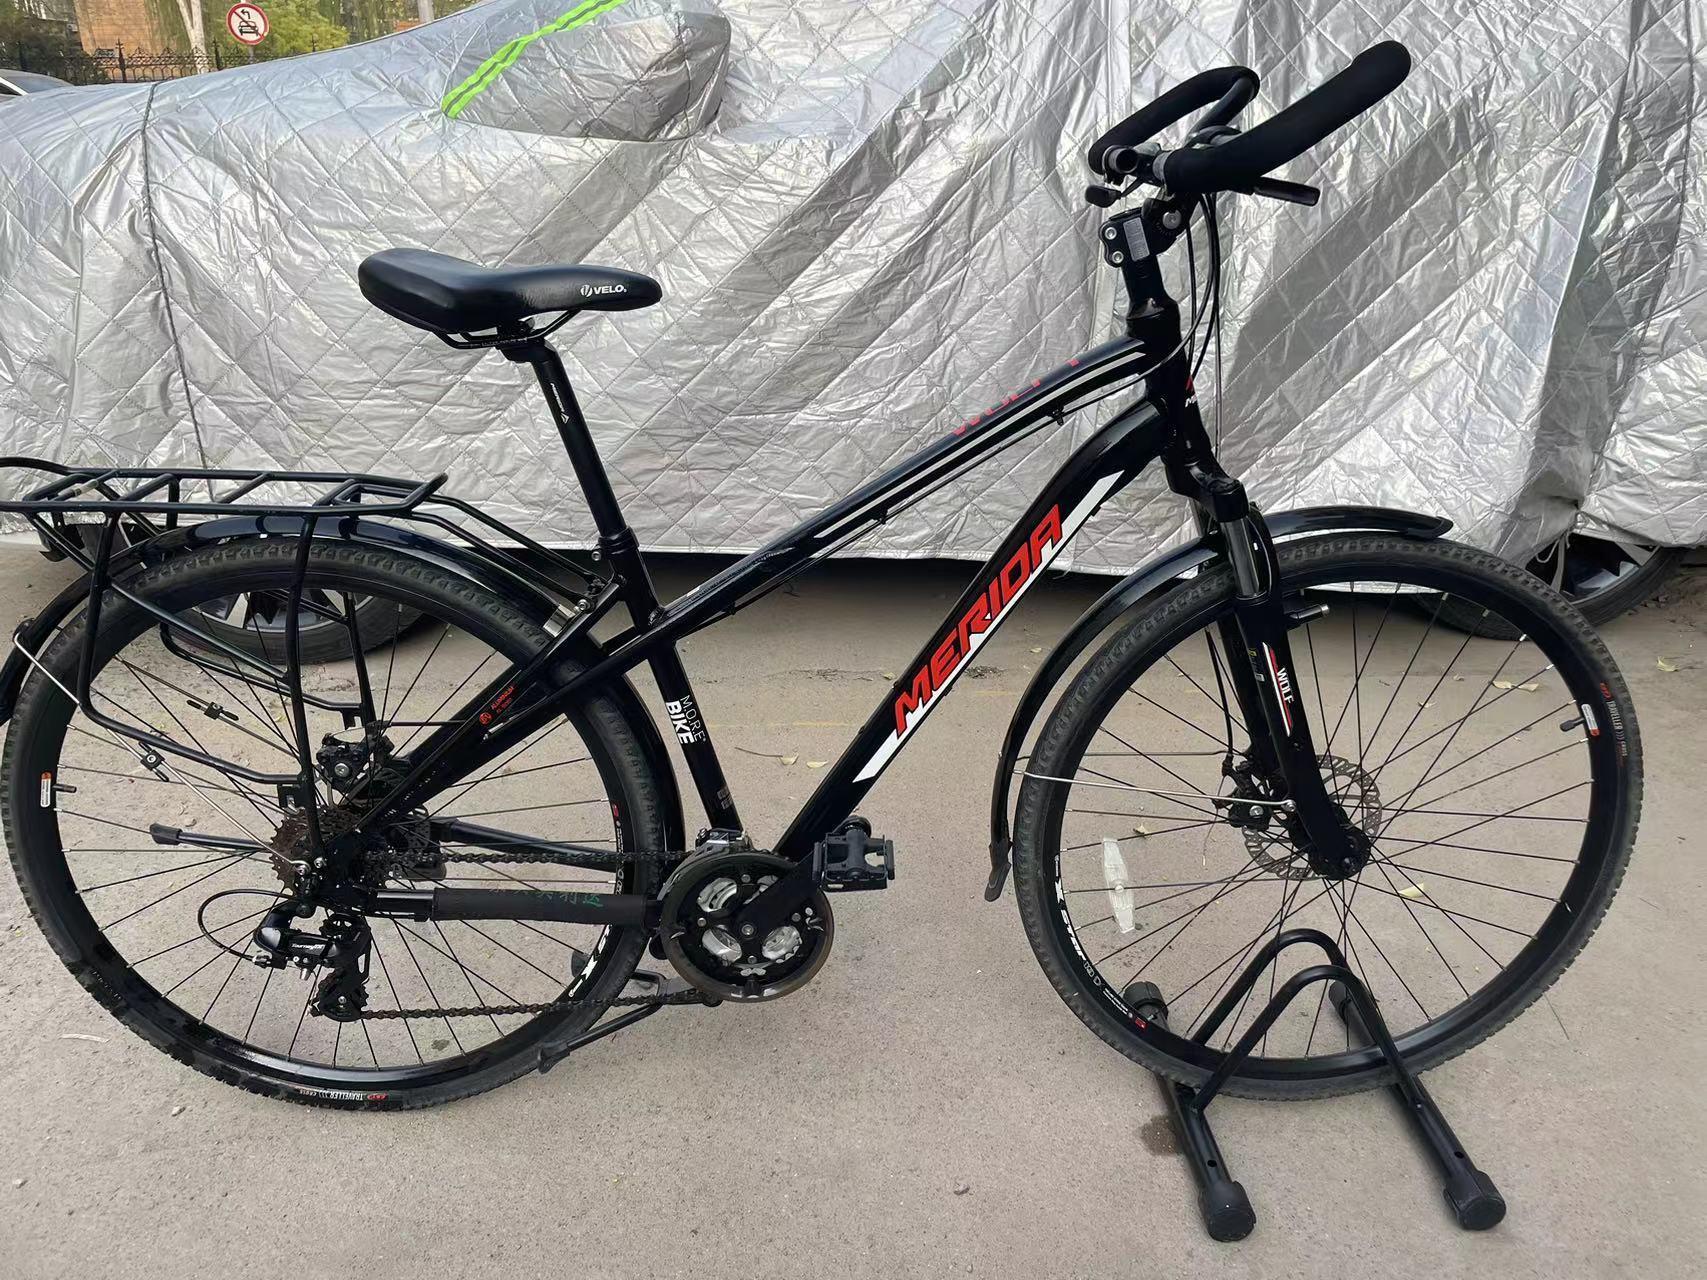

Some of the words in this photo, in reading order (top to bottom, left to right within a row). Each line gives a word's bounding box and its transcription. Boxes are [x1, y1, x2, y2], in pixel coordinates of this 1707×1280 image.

[894, 503, 1063, 739] MERIDA
[665, 700, 696, 744] BIKE
[329, 1089, 363, 1101] TRAVELLER
